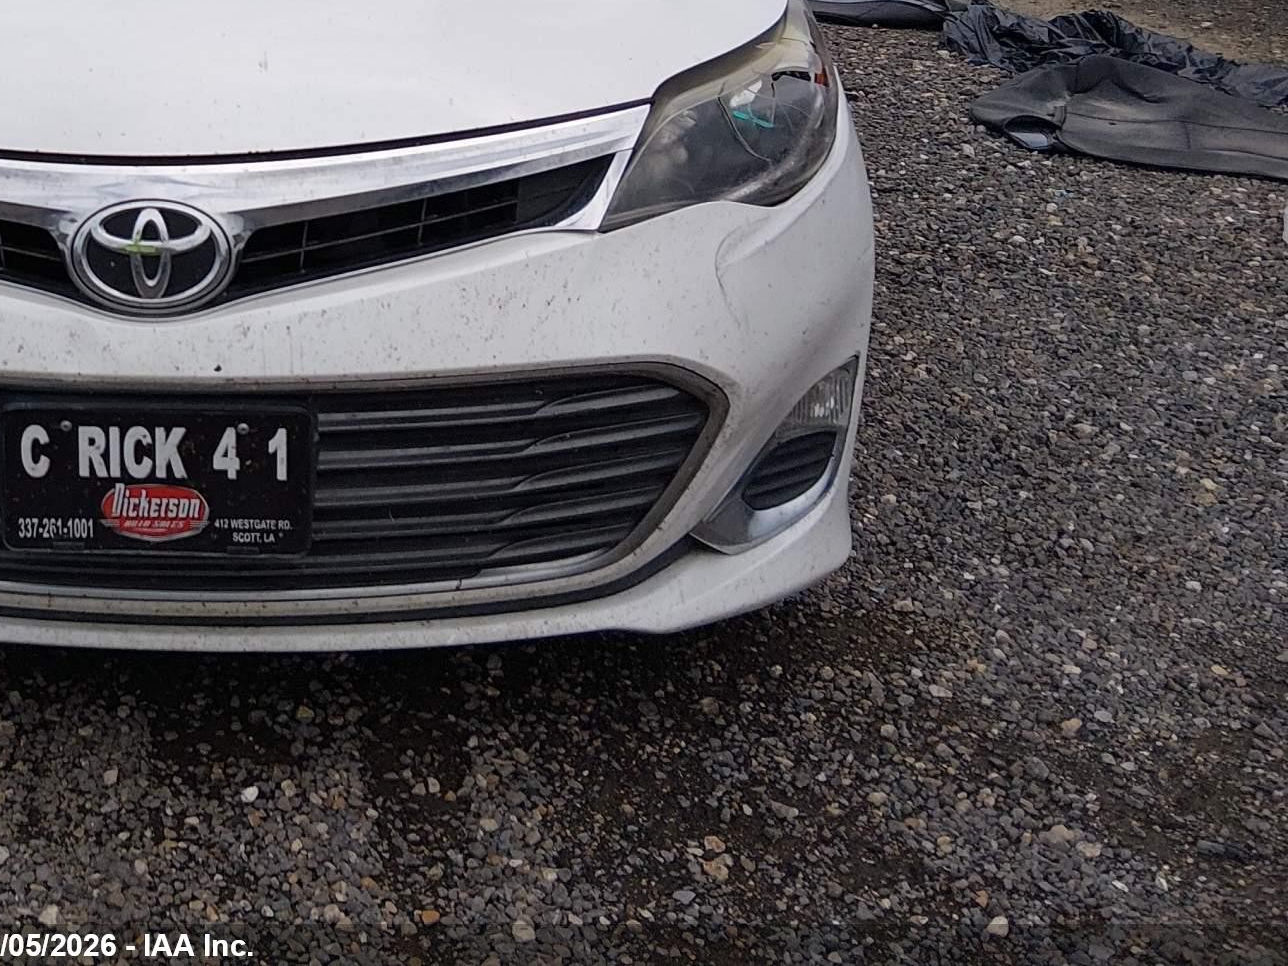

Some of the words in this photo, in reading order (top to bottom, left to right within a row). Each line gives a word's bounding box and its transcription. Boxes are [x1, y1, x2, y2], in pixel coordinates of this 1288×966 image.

[21, 424, 51, 478] C
[78, 425, 188, 479] RICK
[213, 427, 240, 480] 4
[268, 427, 288, 481] 1
[112, 483, 200, 518] Dickerson
[231, 519, 276, 530] WESTGATE
[264, 533, 275, 543] LA
